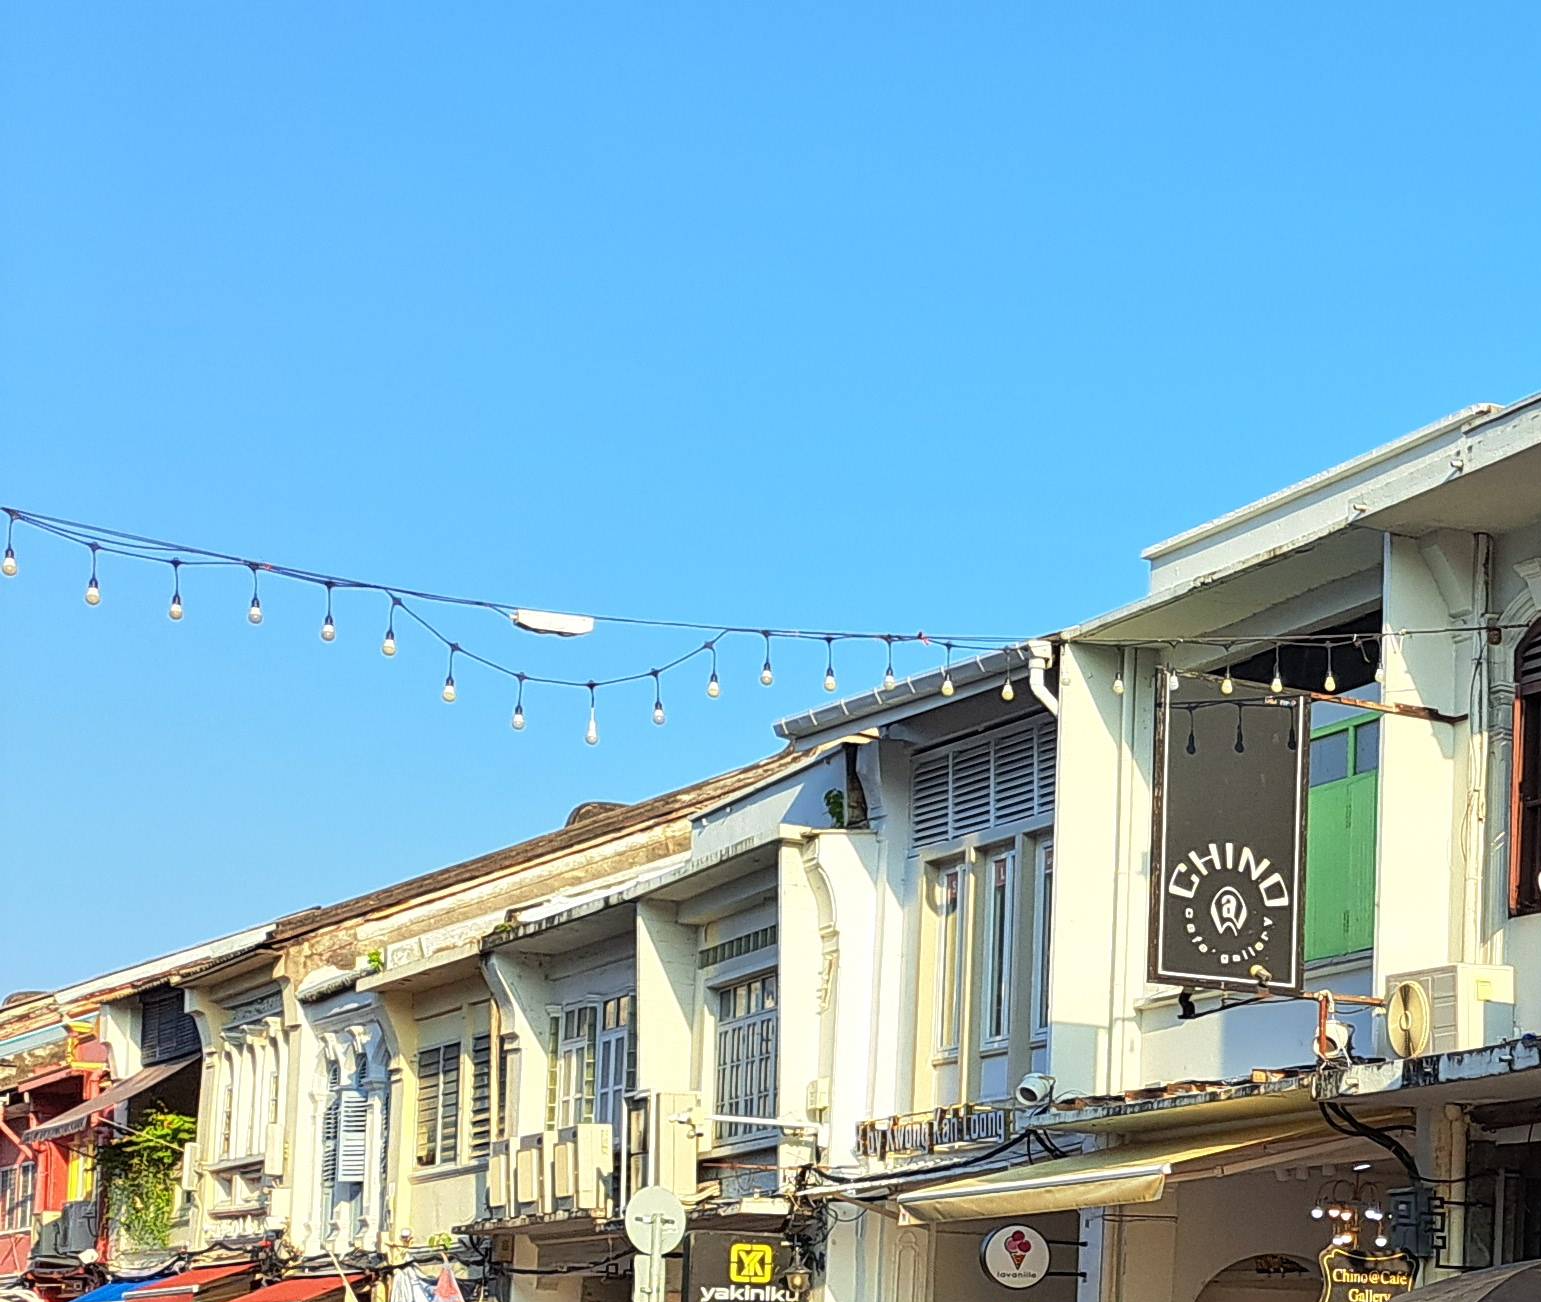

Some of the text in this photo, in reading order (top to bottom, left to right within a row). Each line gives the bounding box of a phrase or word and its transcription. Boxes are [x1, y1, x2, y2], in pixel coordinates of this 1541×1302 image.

[1169, 842, 1289, 907] CHINO
[932, 1107, 958, 1144] Kah
[962, 1110, 1005, 1143] Loong
[700, 1285, 799, 1302] yakiniku
